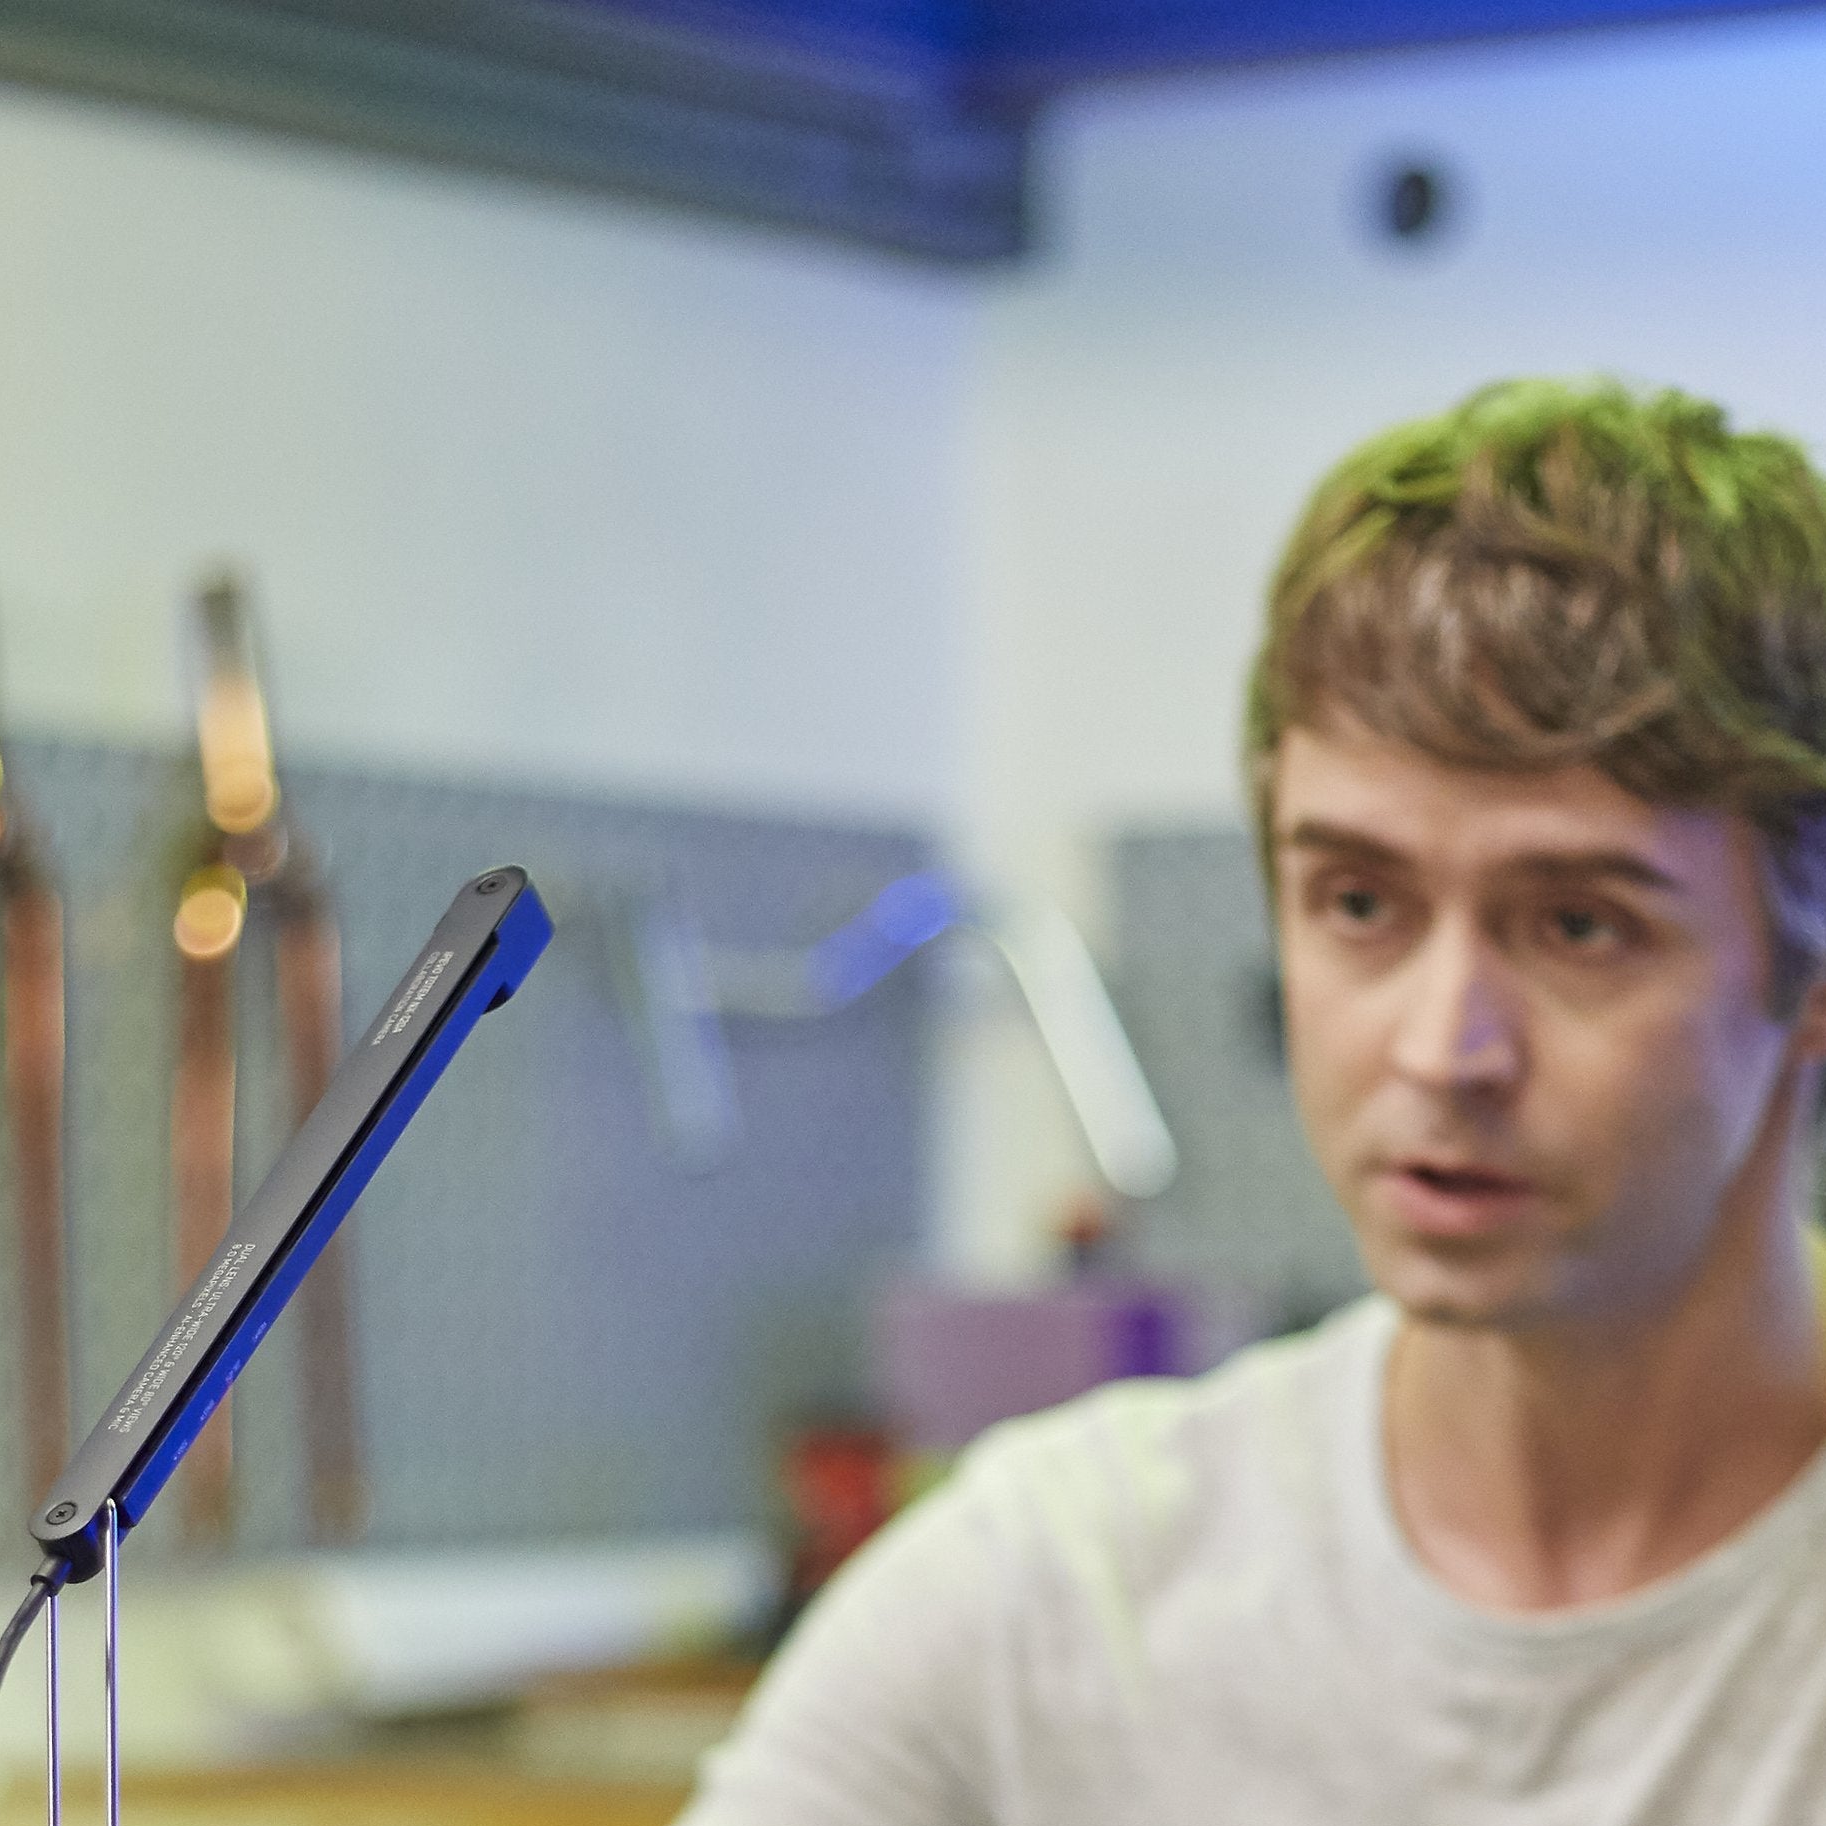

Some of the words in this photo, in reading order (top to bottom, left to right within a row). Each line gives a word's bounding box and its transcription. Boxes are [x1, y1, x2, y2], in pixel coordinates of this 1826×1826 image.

[234, 1244, 255, 1265] DUAL
[191, 1258, 232, 1308] MEGAPIXELS
[182, 1291, 223, 1341] ULTRA-WIDE
[124, 1372, 154, 1406] CAMERA
[149, 1369, 170, 1390] WIDE
[108, 1415, 125, 1430] MIC
[119, 1408, 143, 1433] VIEWS
